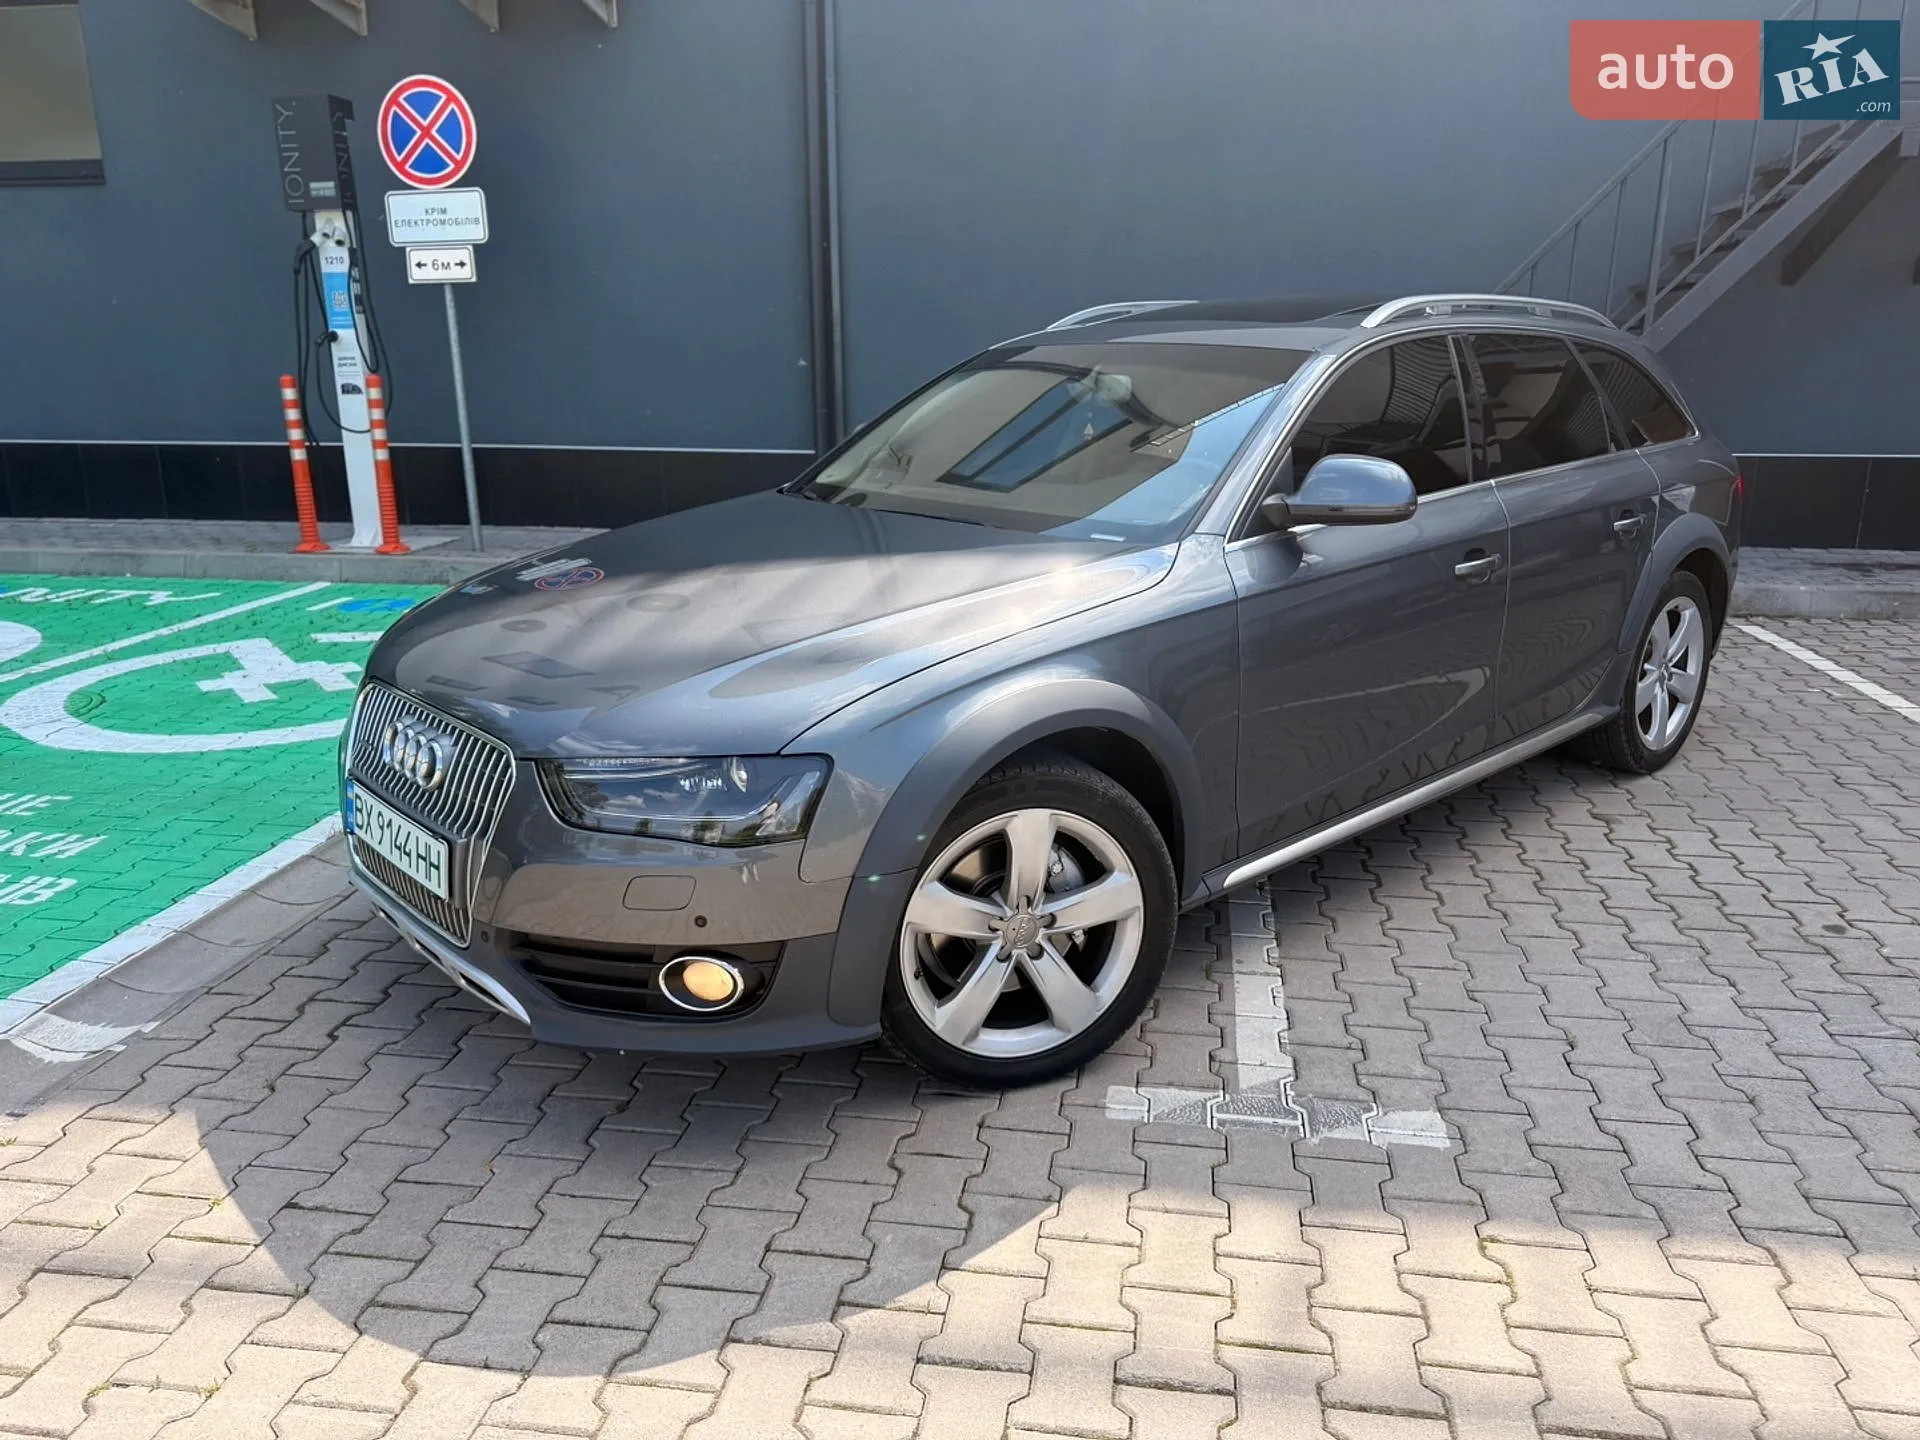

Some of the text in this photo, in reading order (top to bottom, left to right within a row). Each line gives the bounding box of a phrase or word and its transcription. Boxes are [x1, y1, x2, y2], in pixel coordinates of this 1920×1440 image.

[424, 207, 448, 216] КРІМ
[394, 217, 481, 228] ЕЛЕКТРОМОБІЛІВ
[325, 256, 344, 265] 1210
[377, 811, 412, 869] 9144
